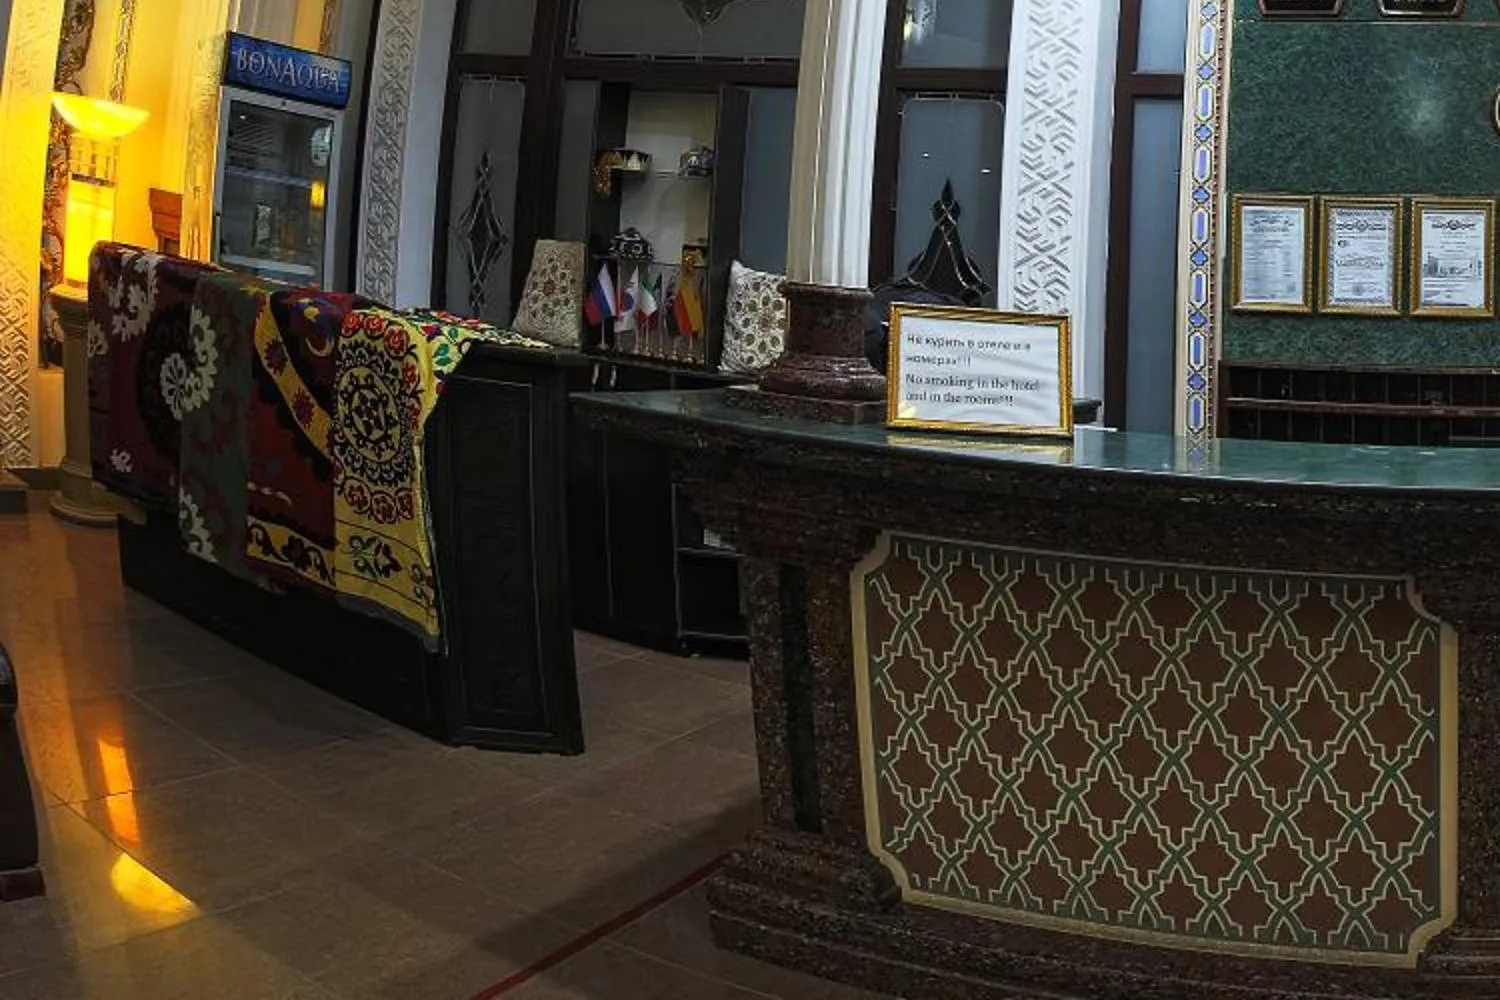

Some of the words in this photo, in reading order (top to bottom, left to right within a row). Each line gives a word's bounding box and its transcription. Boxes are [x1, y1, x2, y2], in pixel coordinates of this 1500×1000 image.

[236, 47, 340, 93] BONAQUA
[905, 373, 923, 385] No
[924, 375, 974, 390] smoking
[977, 376, 989, 389] in
[991, 377, 1009, 390] the
[1011, 378, 1039, 392] hotel
